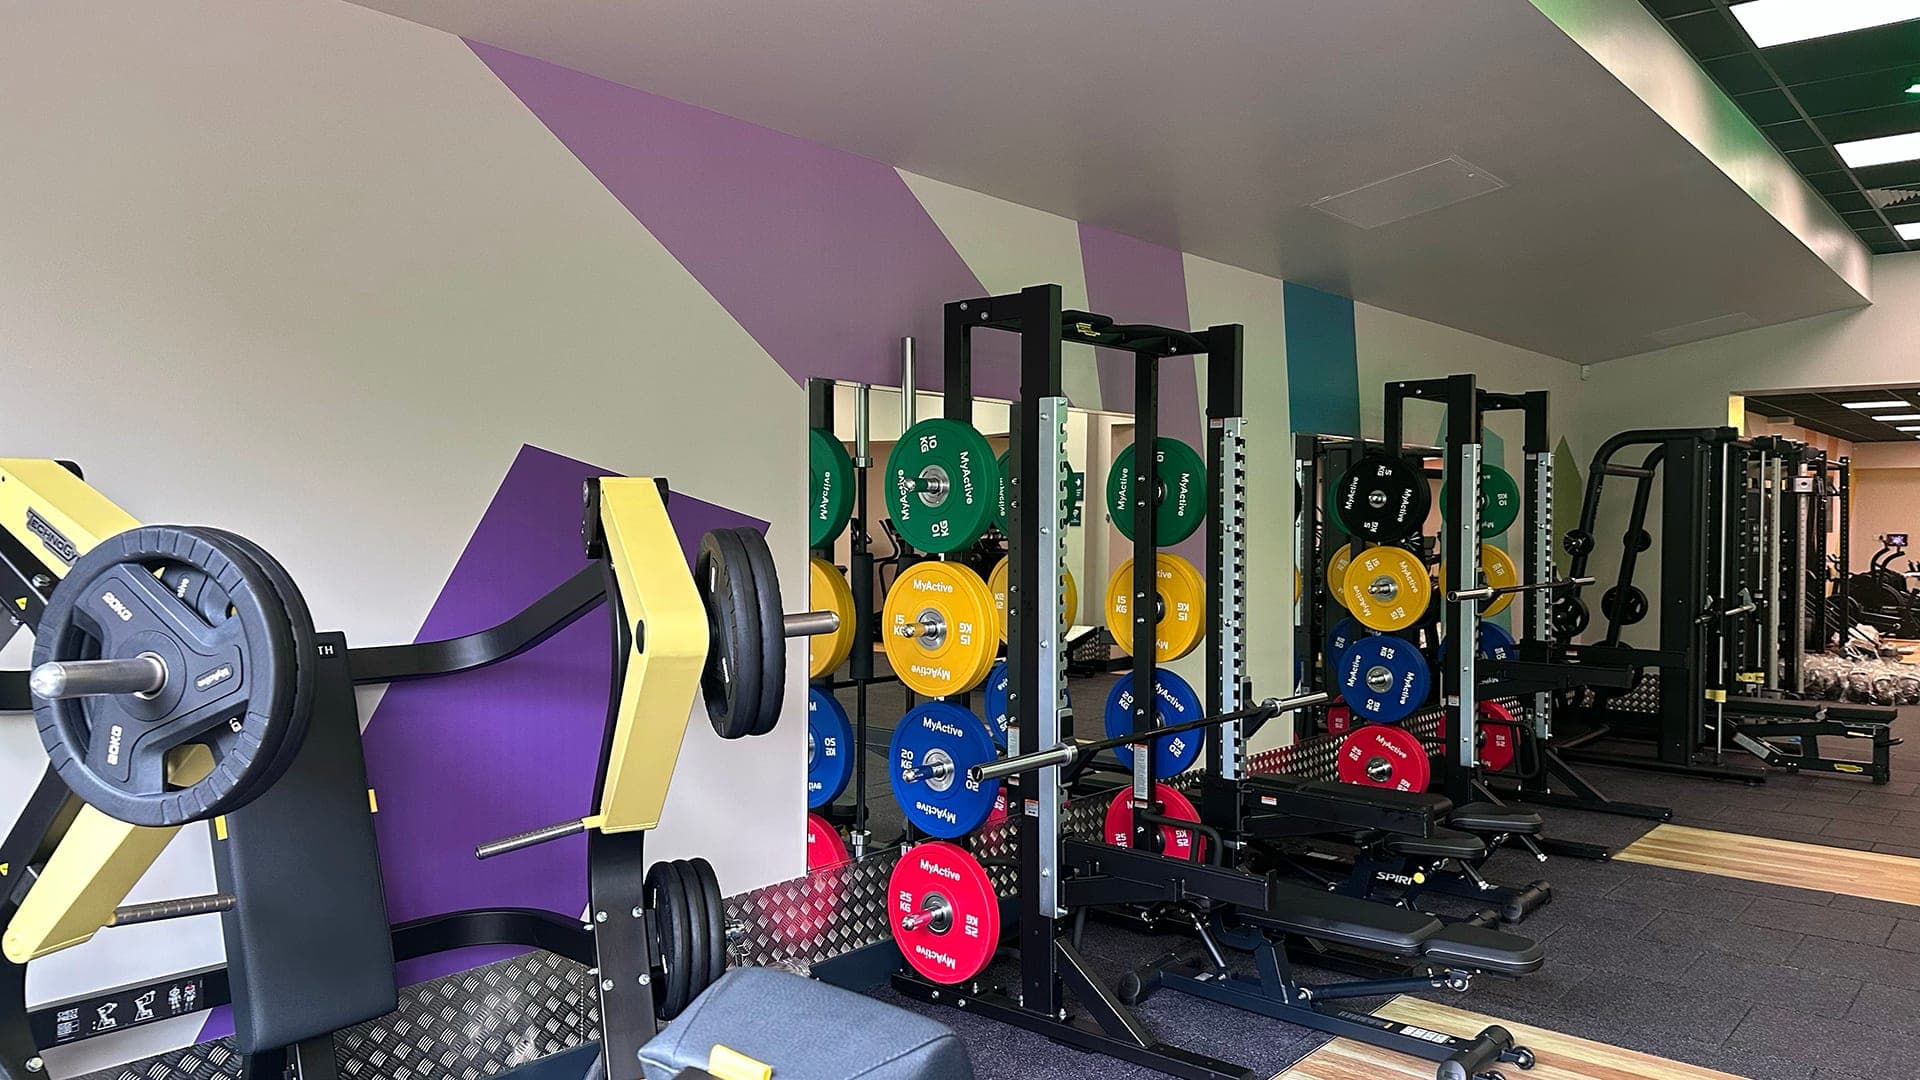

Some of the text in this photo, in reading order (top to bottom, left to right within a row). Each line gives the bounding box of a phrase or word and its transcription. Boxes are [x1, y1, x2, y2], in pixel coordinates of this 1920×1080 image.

[919, 436, 929, 453] KG
[928, 434, 938, 449] 10
[1156, 451, 1165, 462] 10
[959, 451, 974, 505] MyActive
[897, 469, 911, 521] MyActive
[1117, 467, 1129, 510] MyActive
[1177, 472, 1191, 517] MyActive
[1344, 476, 1359, 510] MyActive
[1397, 488, 1412, 523] MyActive
[26, 507, 80, 563] TECHNOGY
[931, 524, 940, 537] 10
[940, 520, 950, 537] KG
[1399, 560, 1419, 594] MyActive
[913, 578, 954, 594] MyActive
[102, 591, 133, 622] 20KG
[1117, 595, 1127, 604] 15
[1353, 585, 1372, 617] MyActive
[1115, 604, 1128, 613] KG
[1177, 602, 1190, 612] KG
[895, 614, 905, 624] 15
[1178, 612, 1188, 621] 15
[959, 622, 973, 634] KG
[960, 634, 971, 646] 15
[317, 644, 335, 656] TH
[911, 664, 951, 681] MyActive
[1346, 654, 1362, 688] MyActive
[1399, 671, 1415, 705] MyActive
[1121, 690, 1134, 704] 20
[1118, 698, 1130, 711] KG
[922, 716, 963, 738] MyActive
[1168, 744, 1182, 758] 20
[1172, 737, 1186, 751] KG
[1375, 734, 1408, 759] MyActive
[900, 748, 914, 760] 20
[900, 759, 913, 770] KG
[965, 779, 980, 792] 20
[916, 801, 957, 824] MyActive
[1114, 833, 1127, 842] 25
[1175, 829, 1187, 839] KG
[1176, 838, 1190, 847] 25
[920, 858, 961, 882] MyActive
[1375, 871, 1414, 886] SPIRI
[899, 890, 912, 903] 25
[899, 901, 911, 913] KG
[965, 913, 979, 926] KG
[964, 925, 979, 938] 25
[915, 944, 956, 970] MyActive
